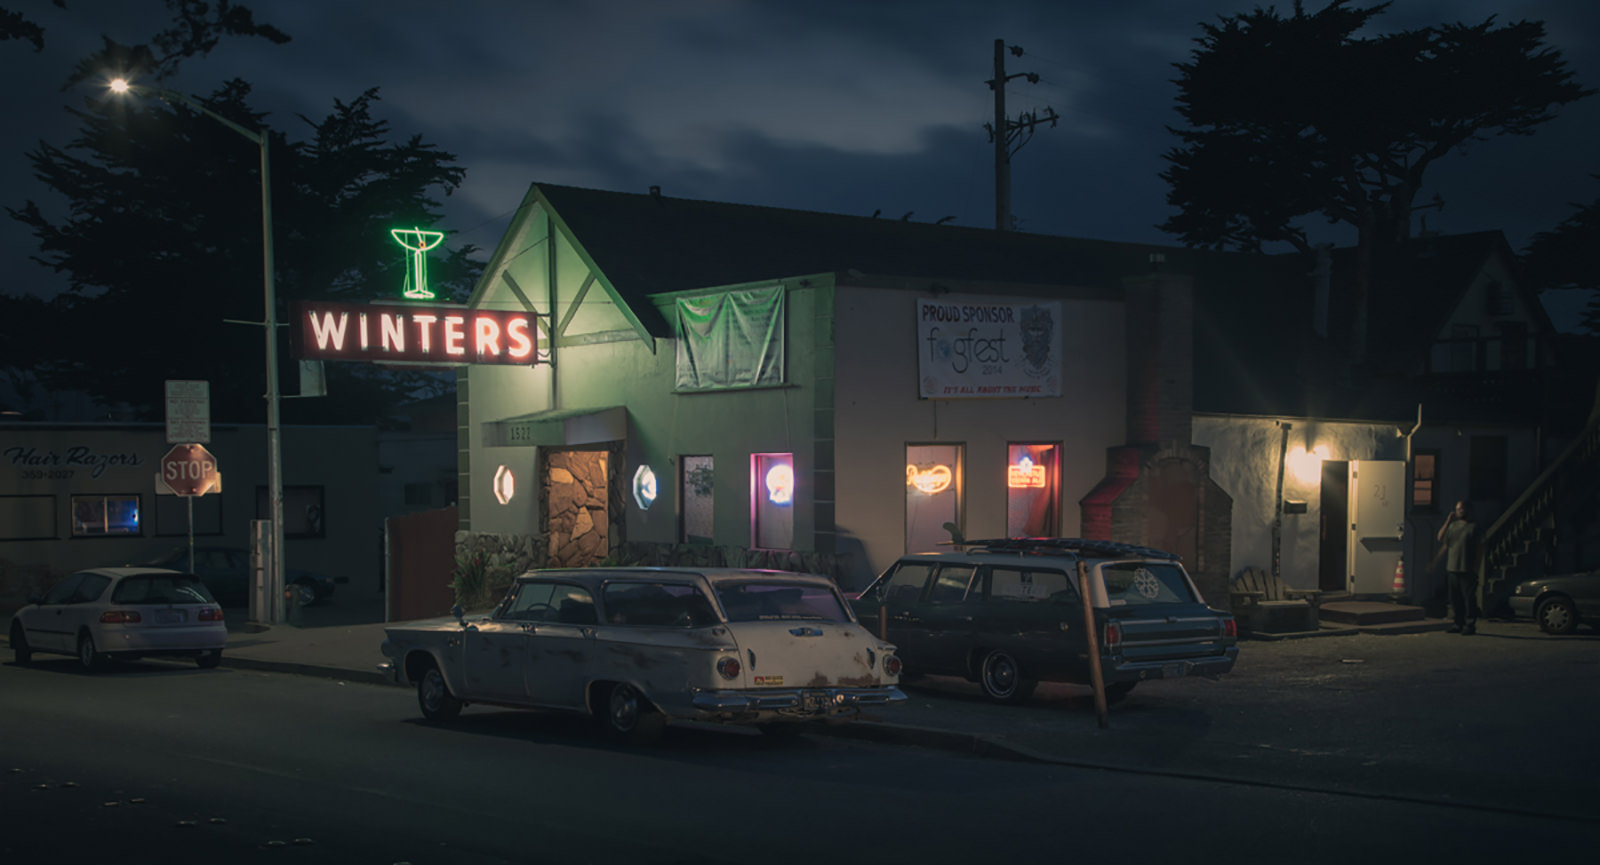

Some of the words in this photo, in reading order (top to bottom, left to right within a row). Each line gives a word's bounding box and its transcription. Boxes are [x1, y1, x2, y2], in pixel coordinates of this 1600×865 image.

[922, 304, 960, 322] PROUD
[962, 306, 1015, 323] SPONSOR
[308, 310, 532, 358] WINTERS
[982, 365, 1002, 375] 2014
[511, 426, 531, 440] 1522
[3, 446, 61, 465] Hair
[66, 446, 142, 479] Razors
[166, 460, 213, 480] STOP
